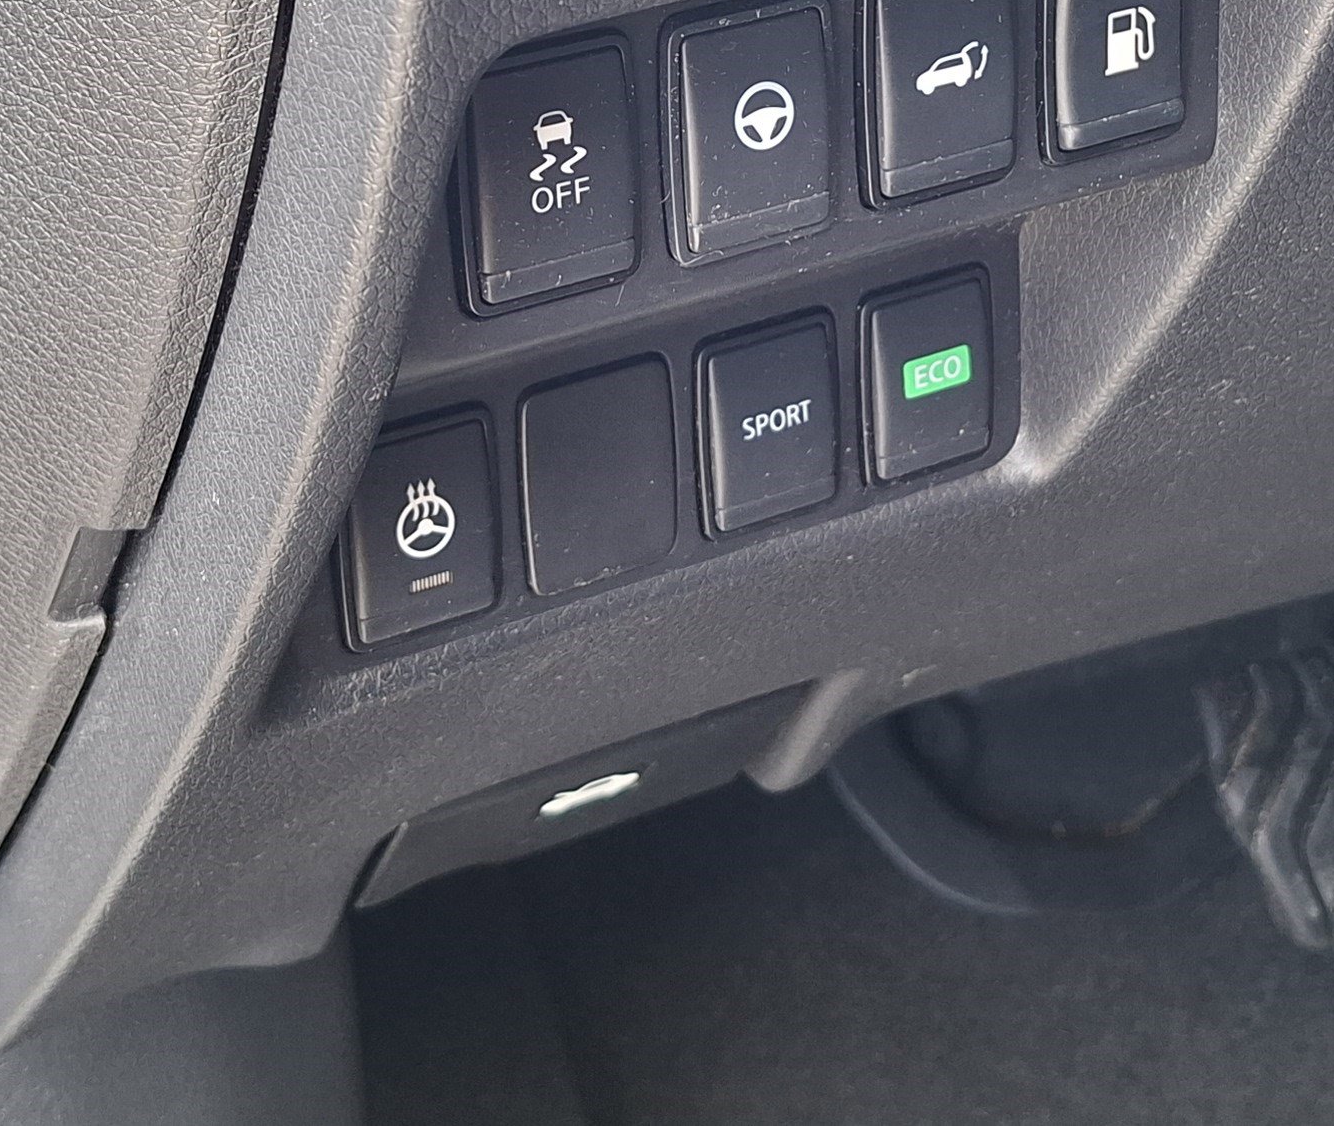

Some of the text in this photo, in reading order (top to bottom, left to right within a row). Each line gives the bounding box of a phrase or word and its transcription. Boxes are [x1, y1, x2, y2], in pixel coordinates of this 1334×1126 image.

[531, 176, 590, 213] OFF
[913, 355, 962, 390] ECO
[742, 399, 812, 441] SPORT
